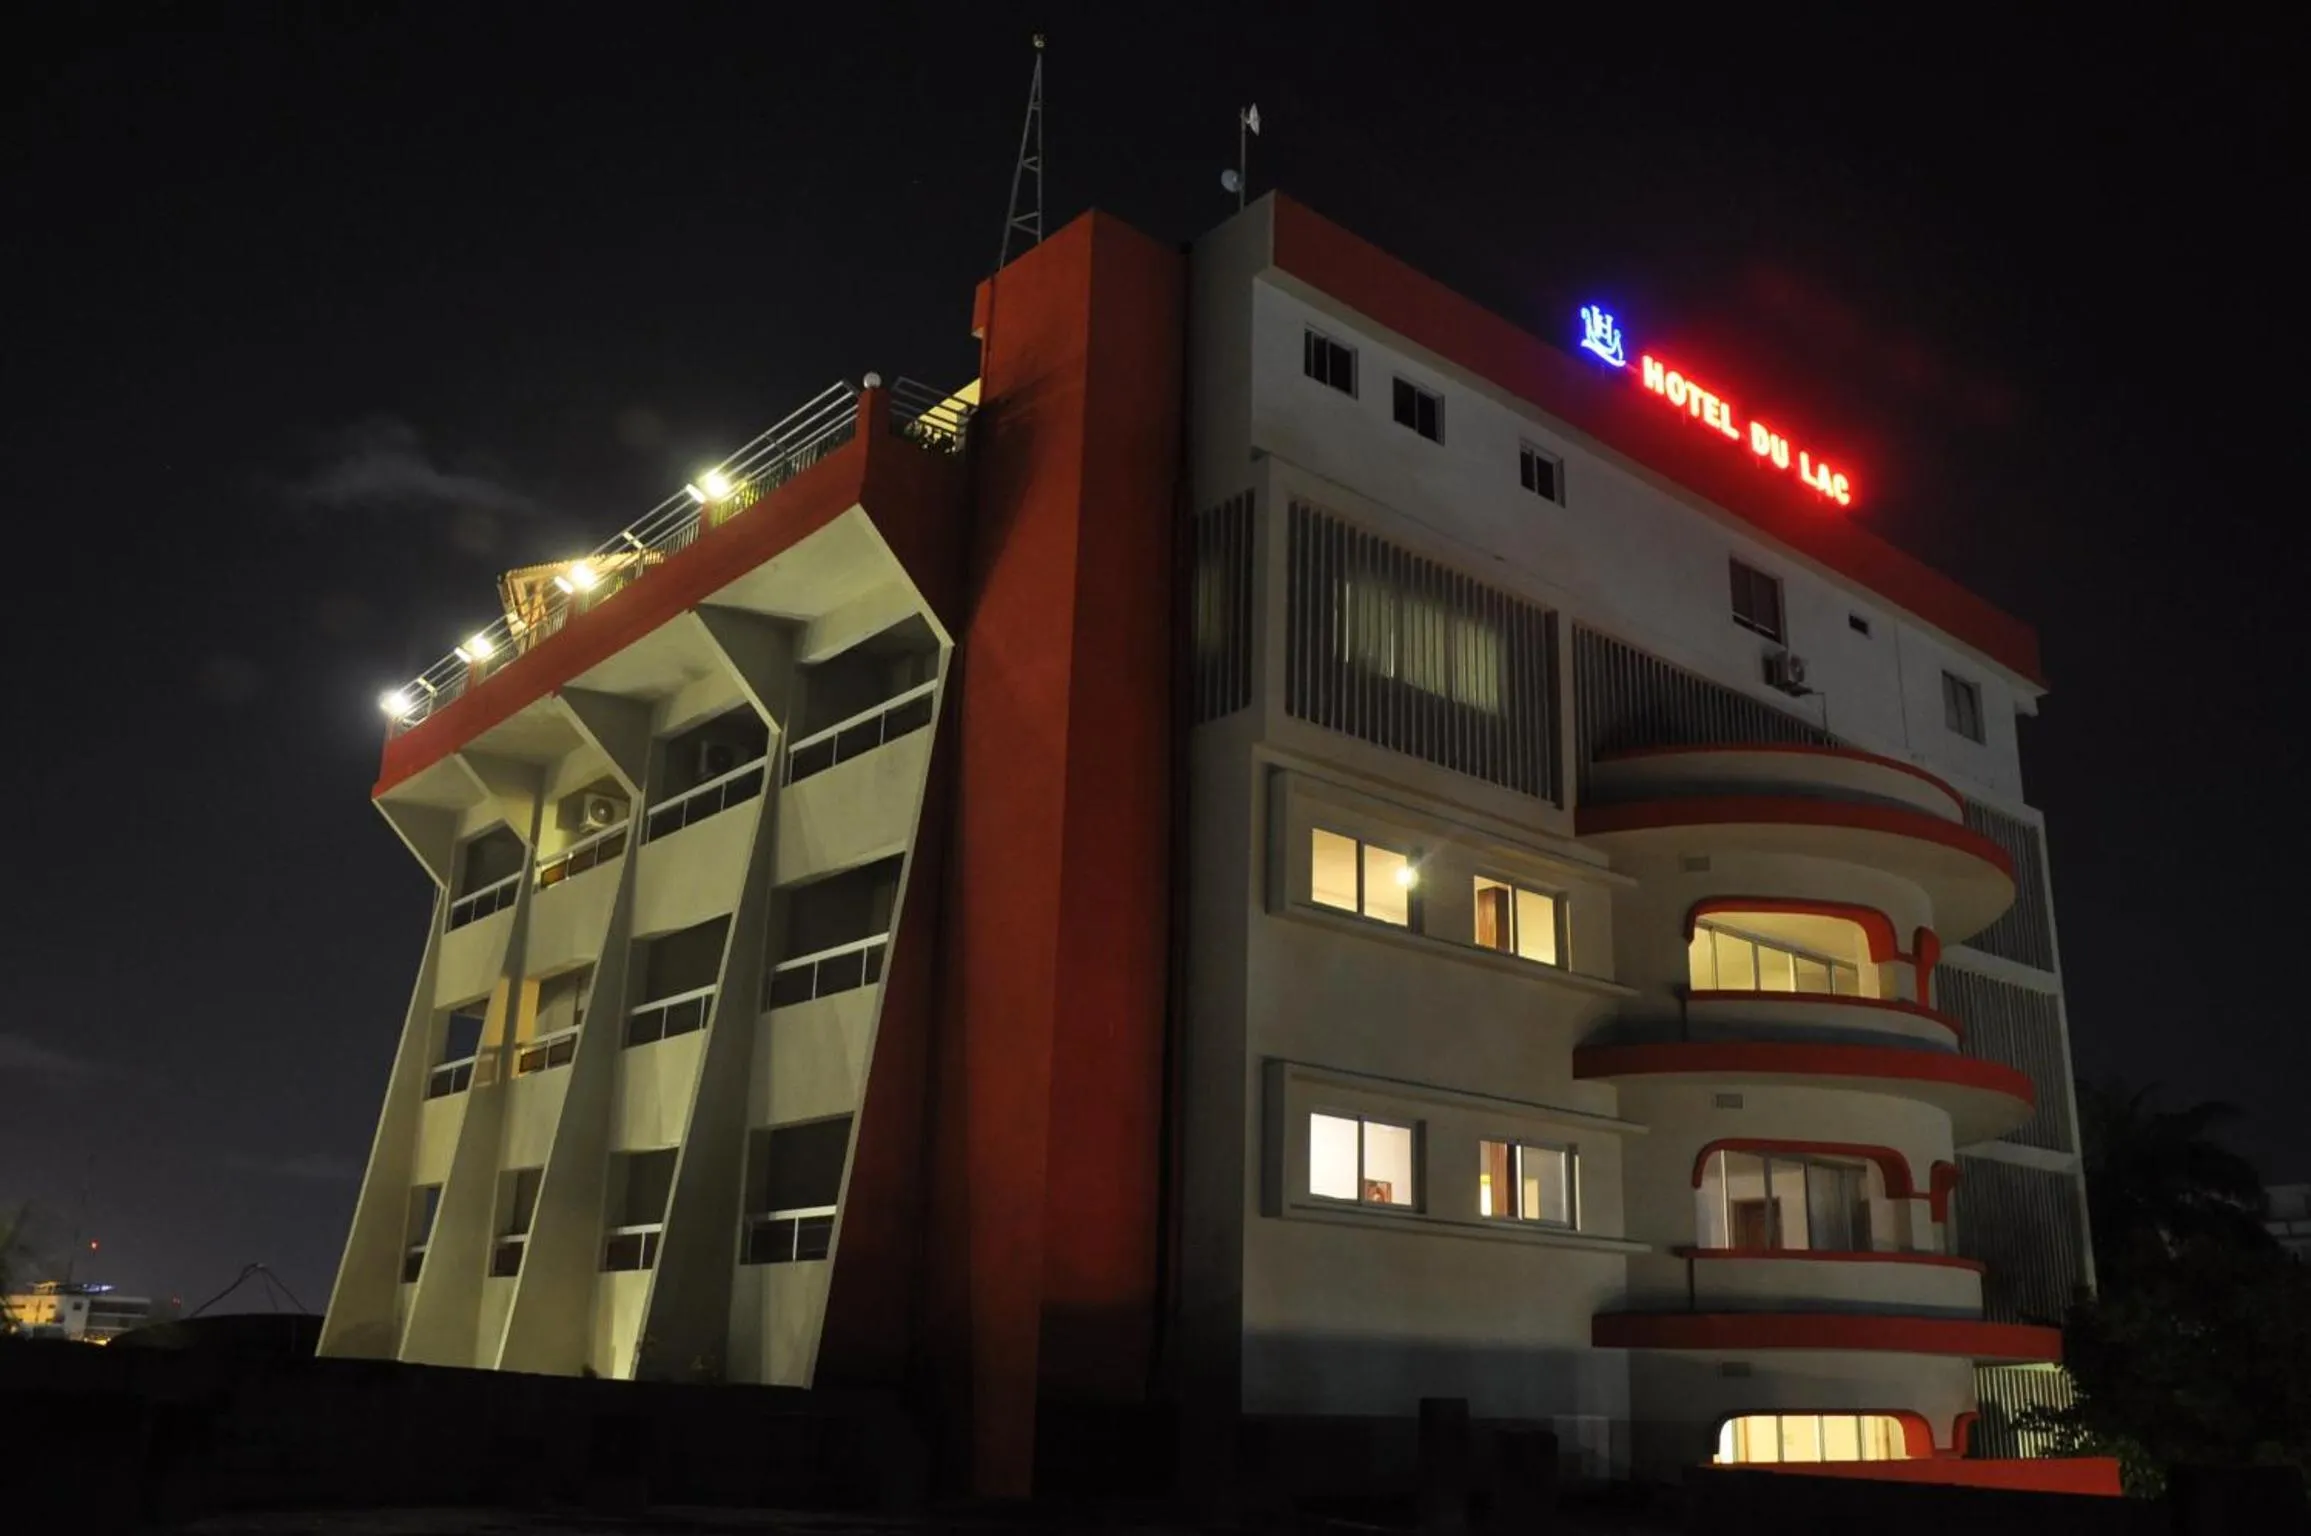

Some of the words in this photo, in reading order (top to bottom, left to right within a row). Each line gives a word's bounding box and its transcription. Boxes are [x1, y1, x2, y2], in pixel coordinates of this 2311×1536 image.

[1642, 355, 1739, 439] HOTEL
[1750, 421, 1789, 468] DU
[1800, 451, 1850, 505] LAC
